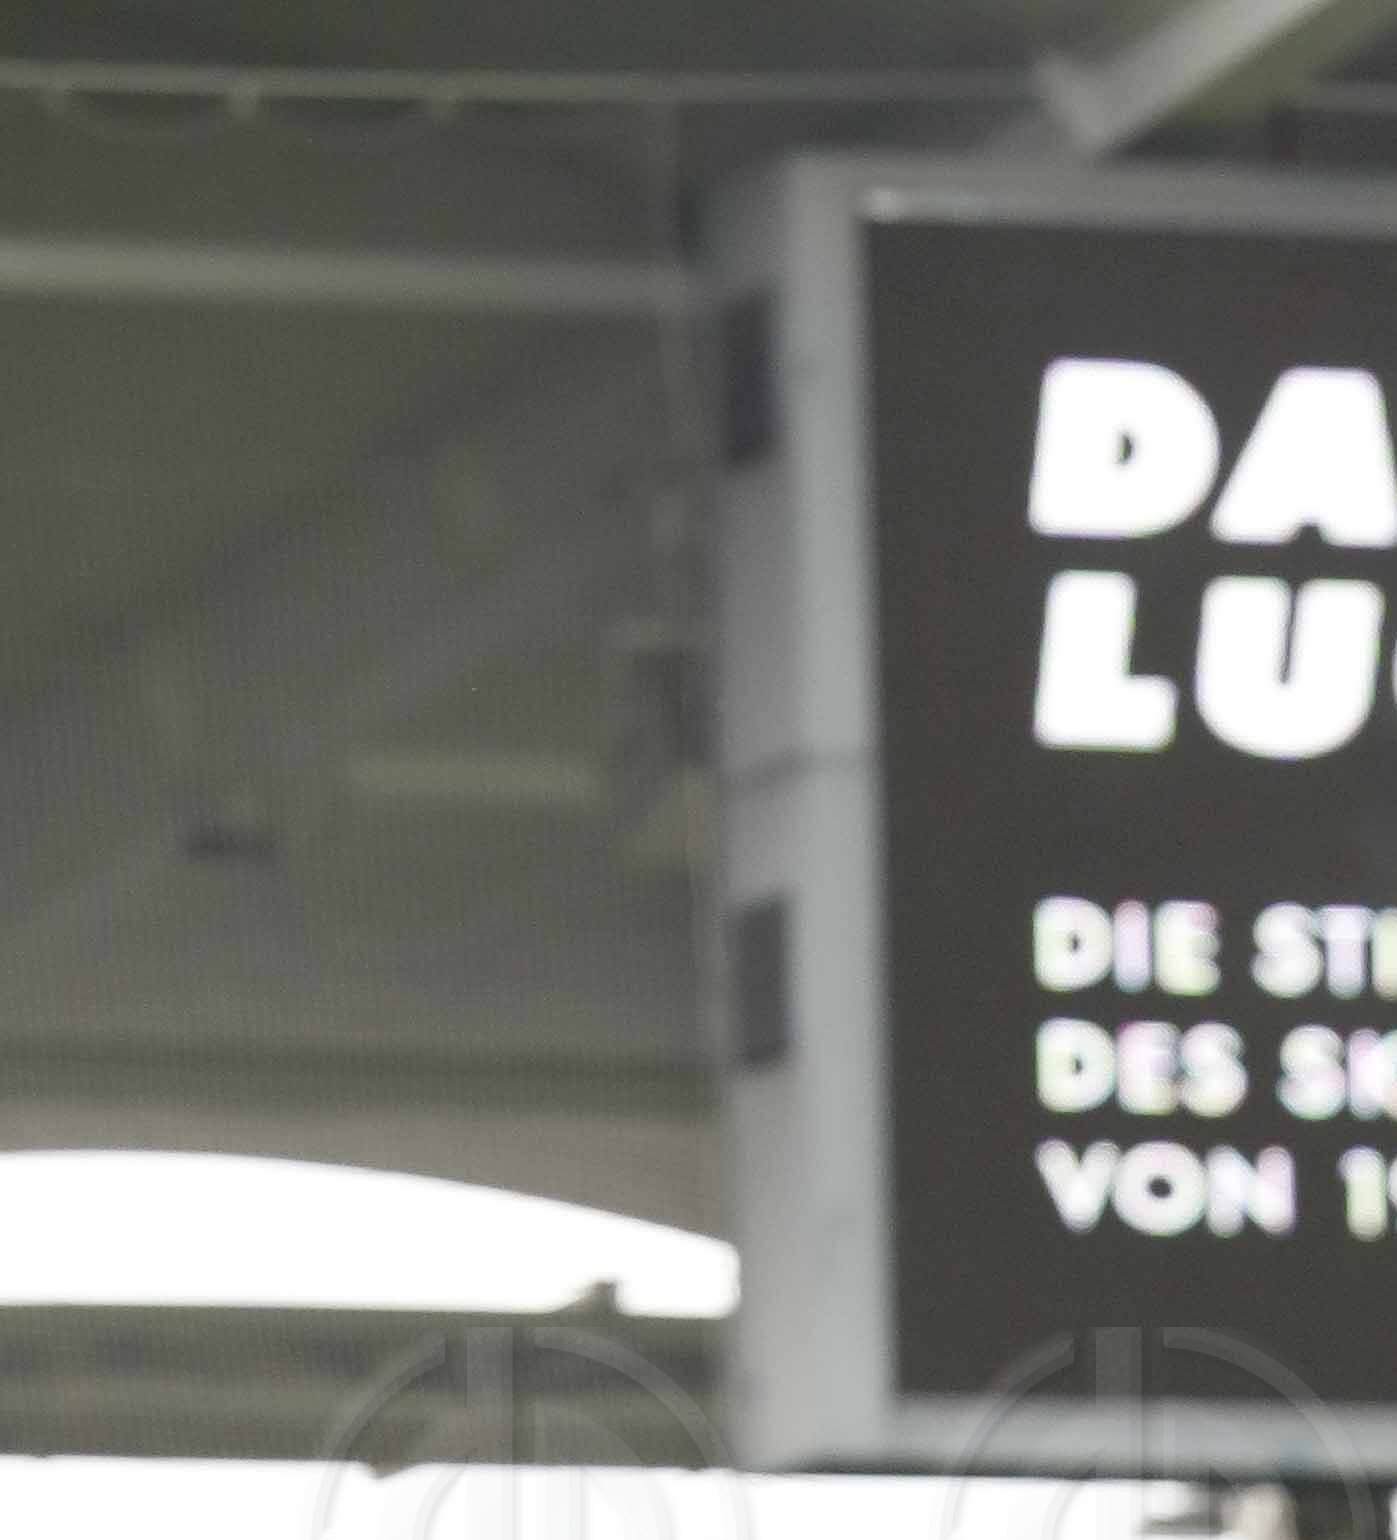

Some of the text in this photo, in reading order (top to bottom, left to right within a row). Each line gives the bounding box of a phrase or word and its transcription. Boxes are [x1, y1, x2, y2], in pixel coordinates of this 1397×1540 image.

[1033, 897, 1219, 996] DIE
[1035, 1020, 1247, 1115] DES
[1038, 1142, 1295, 1237] VON
